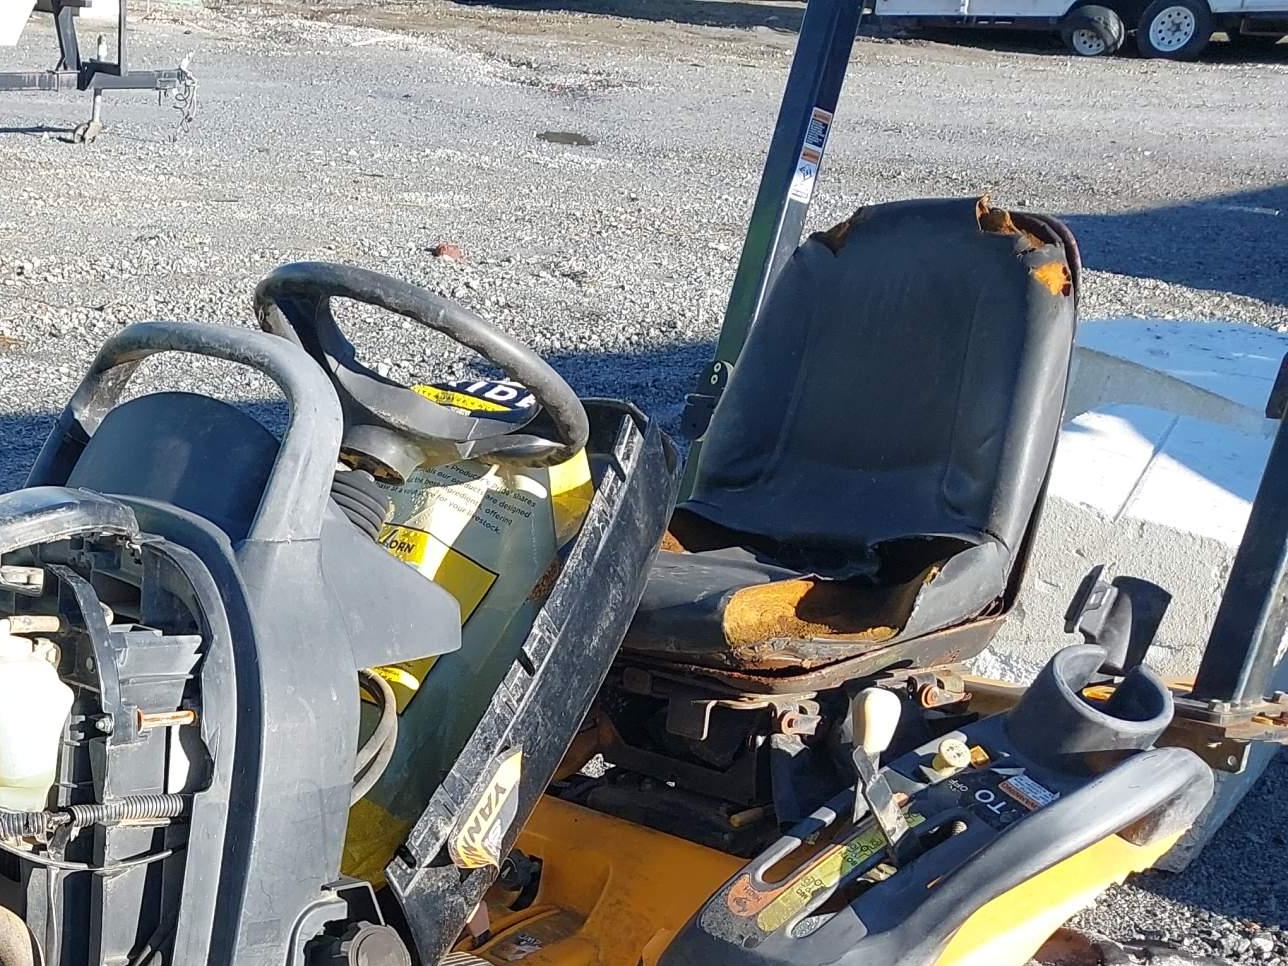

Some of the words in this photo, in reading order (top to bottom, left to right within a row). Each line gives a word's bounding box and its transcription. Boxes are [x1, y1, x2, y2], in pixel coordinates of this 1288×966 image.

[485, 494, 498, 505] are
[498, 501, 532, 518] designed
[513, 492, 536, 508] shares
[485, 508, 513, 525] offering
